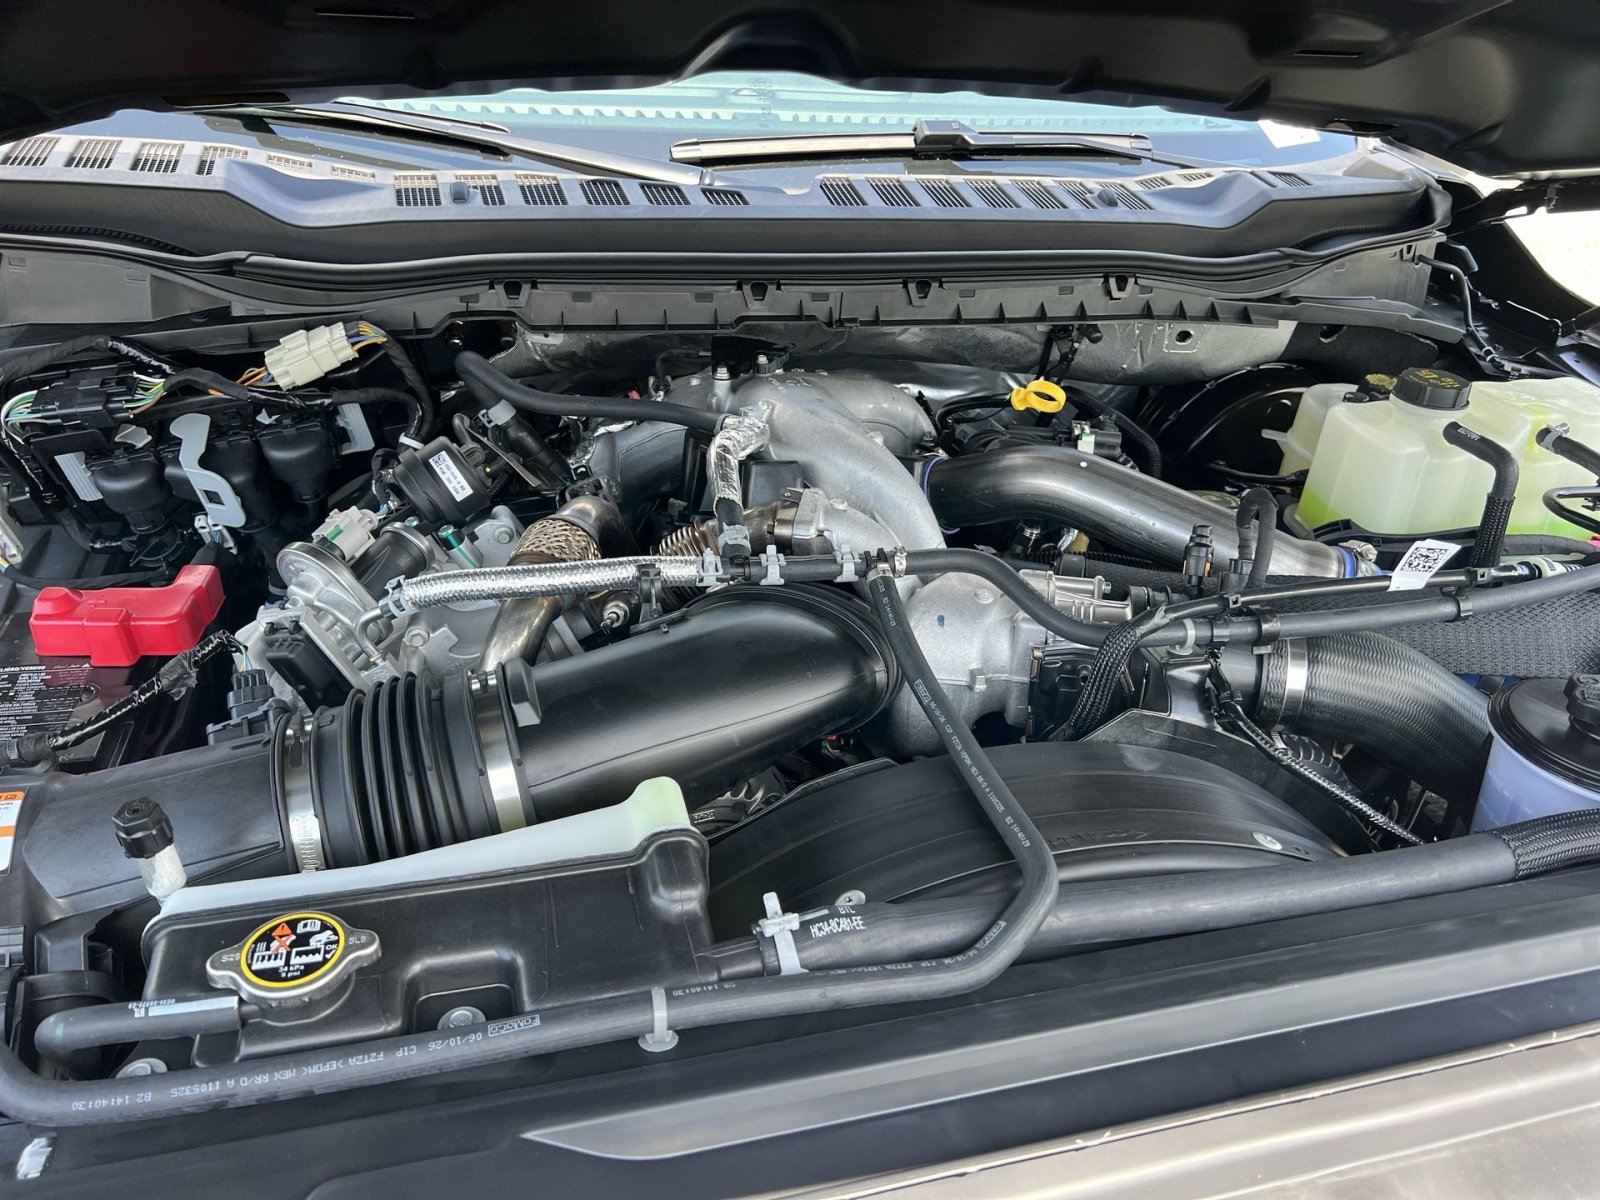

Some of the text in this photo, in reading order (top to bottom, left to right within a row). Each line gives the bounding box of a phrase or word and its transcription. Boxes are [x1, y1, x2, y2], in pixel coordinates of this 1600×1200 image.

[427, 1032, 483, 1051] 06/10/26
[396, 1044, 417, 1057] CIP
[273, 1068, 297, 1080] MEX
[136, 1091, 152, 1103] B2
